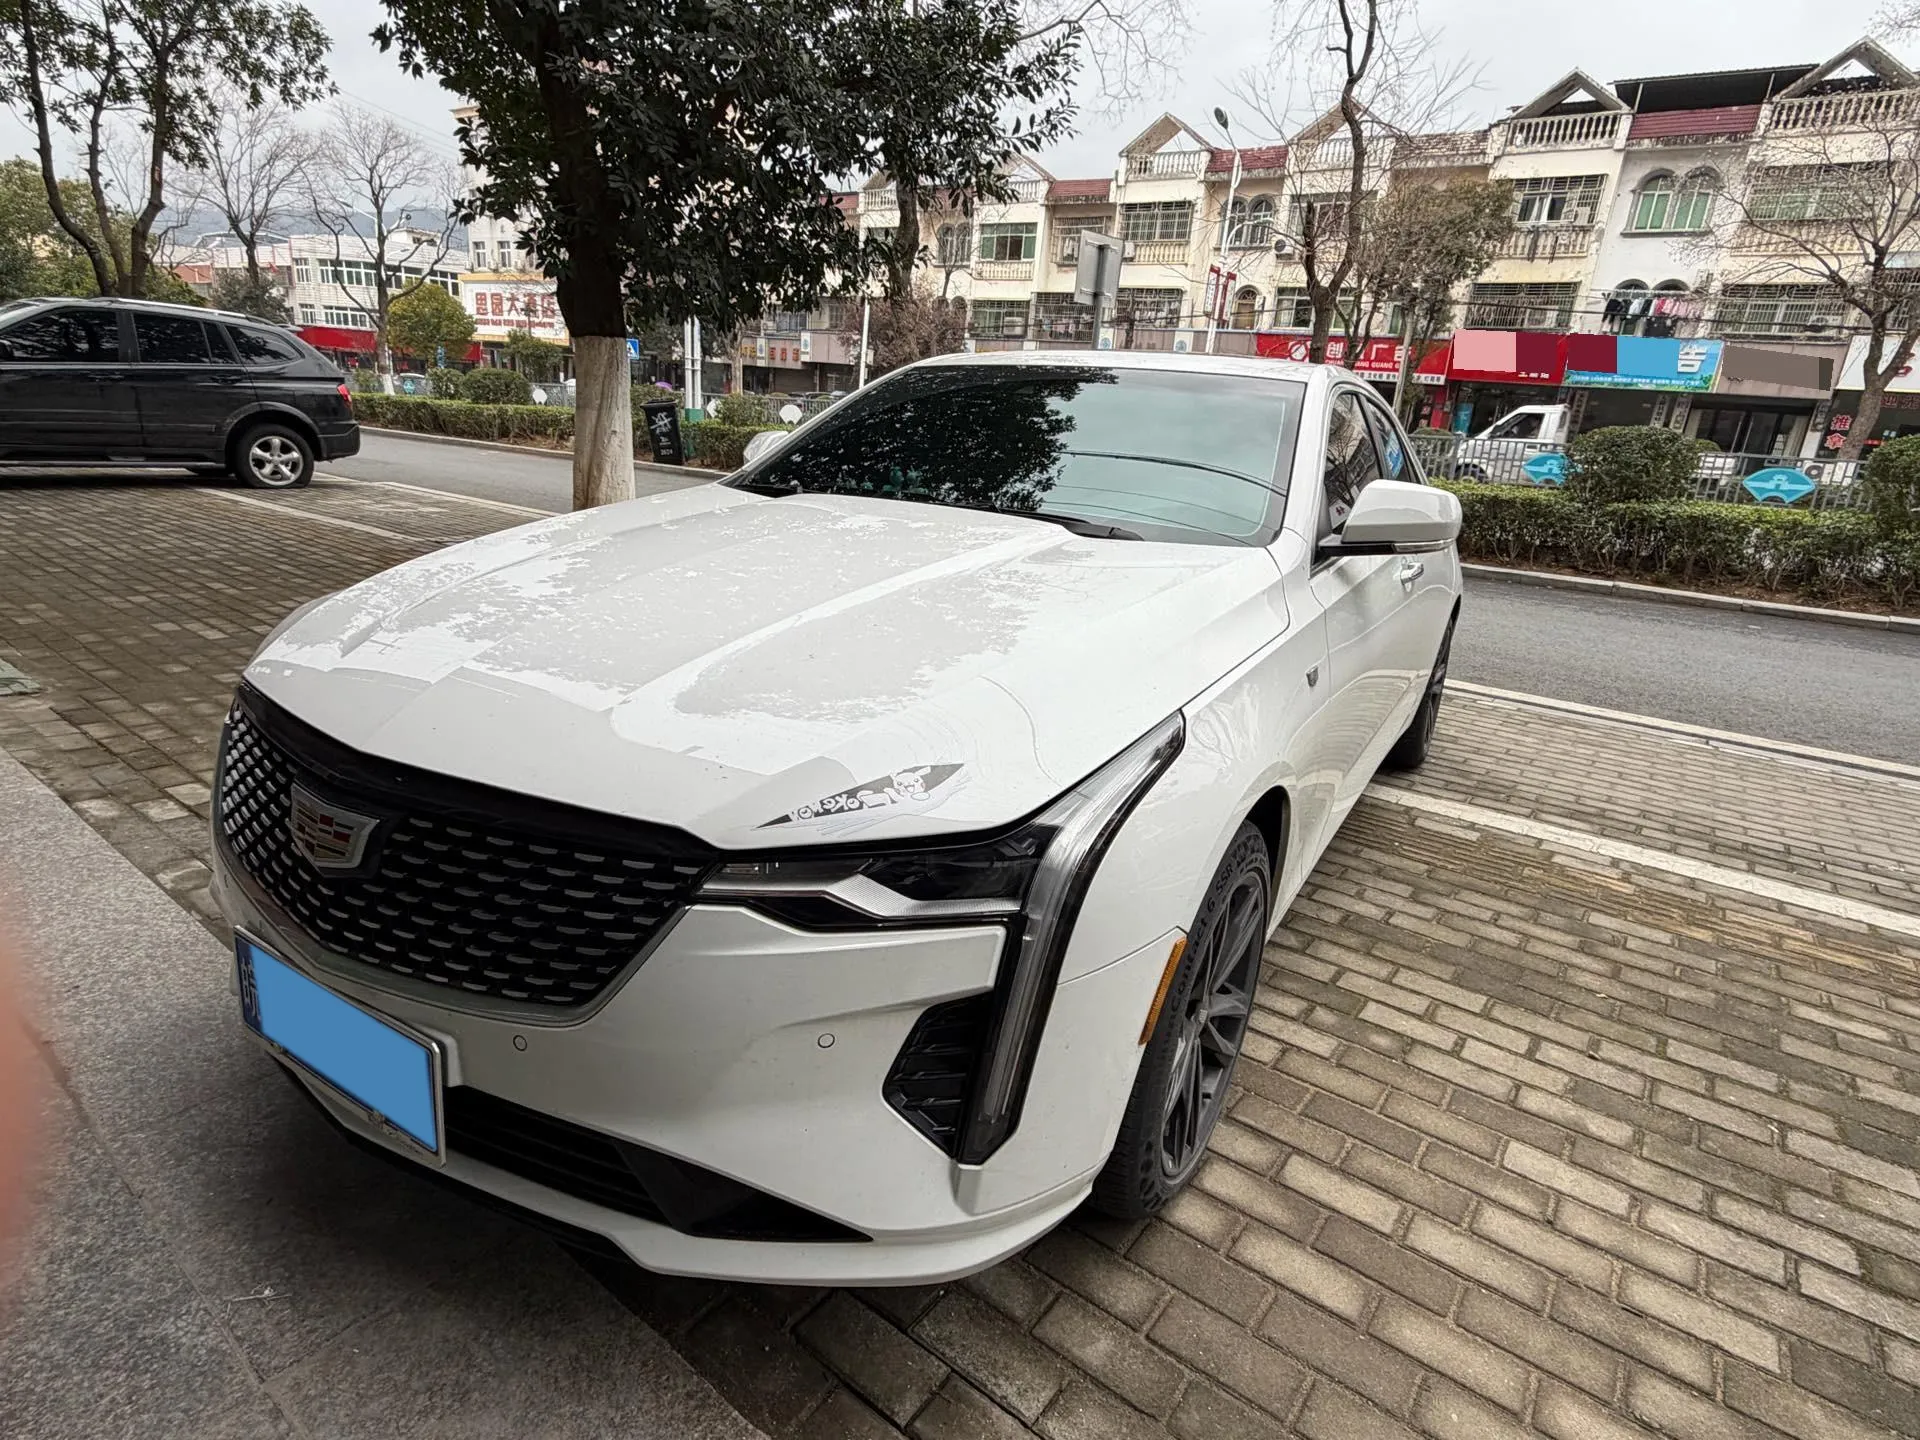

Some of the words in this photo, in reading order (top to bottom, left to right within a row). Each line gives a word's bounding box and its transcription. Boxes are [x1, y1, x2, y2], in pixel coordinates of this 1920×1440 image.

[1326, 341, 1412, 361] 创广告
[1371, 361, 1394, 369] GUANG
[1207, 899, 1216, 913] 6
[1215, 867, 1234, 896] SSR
